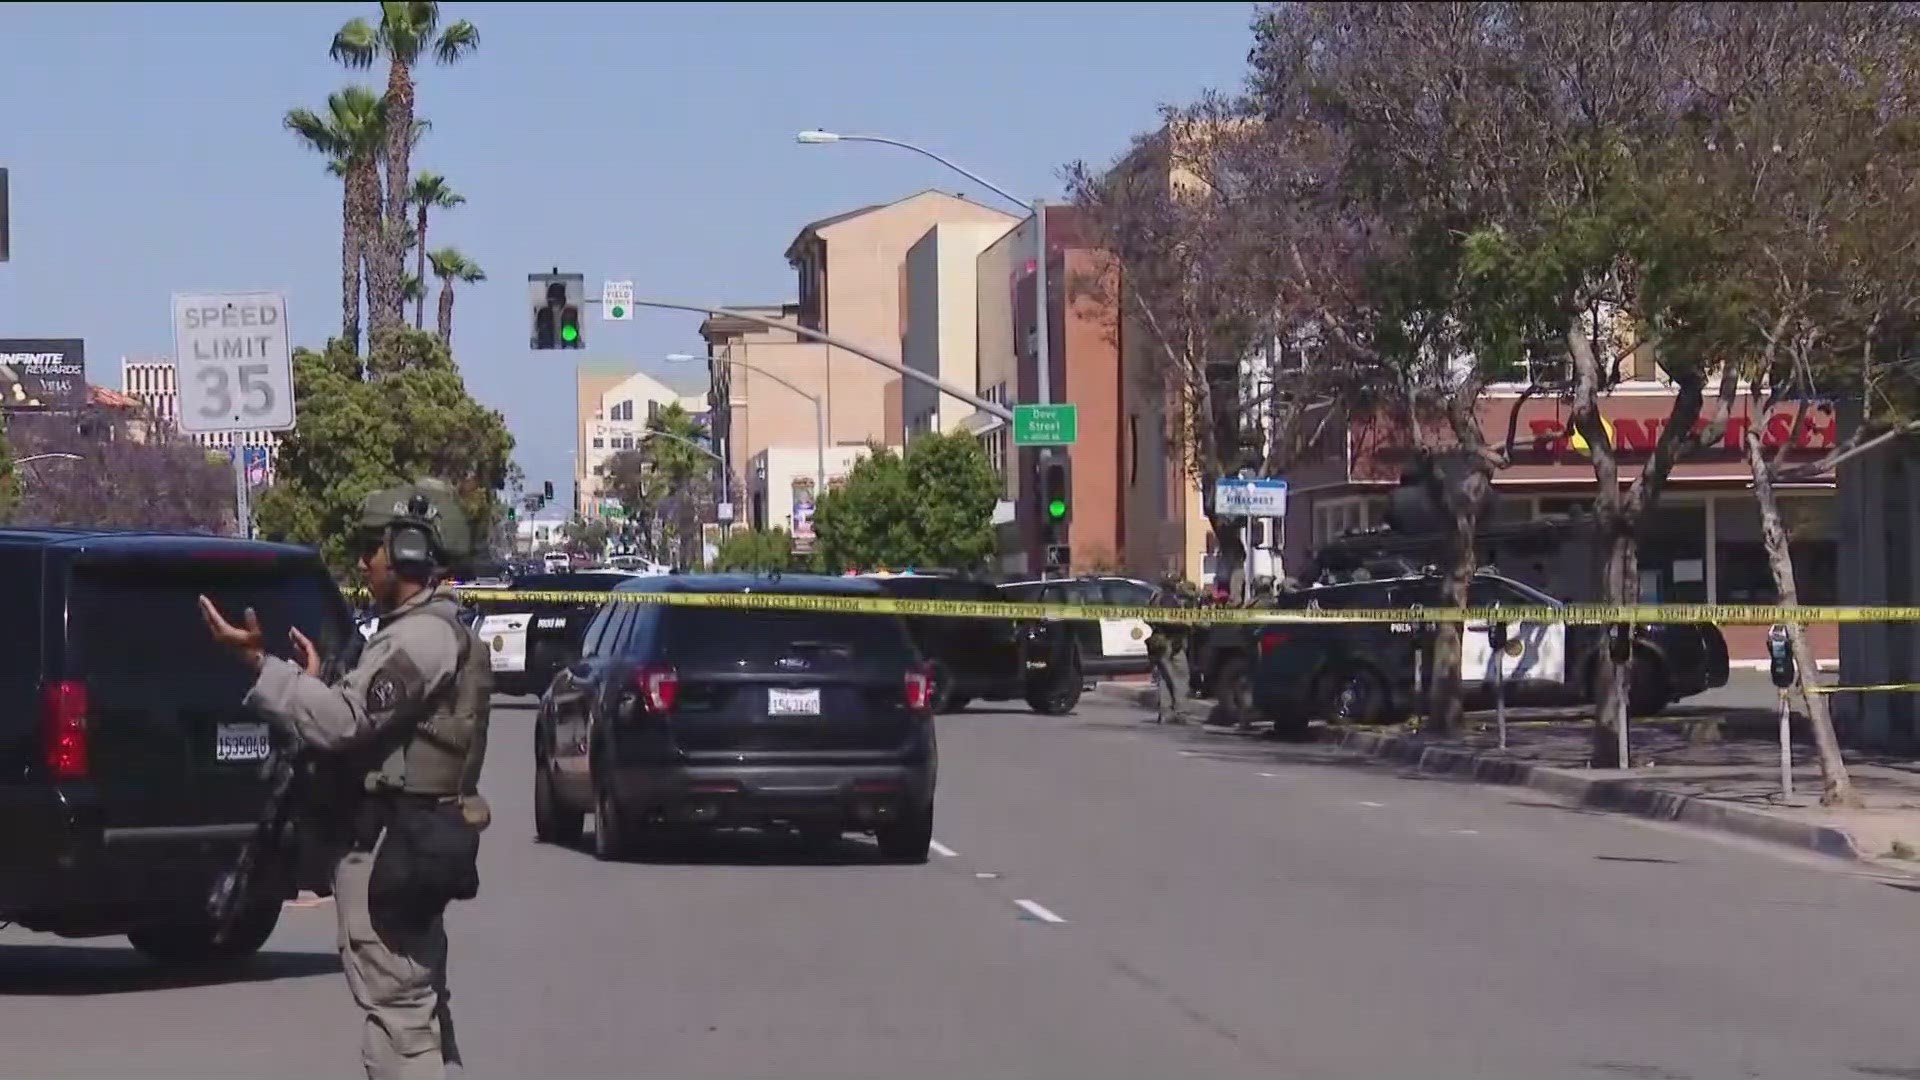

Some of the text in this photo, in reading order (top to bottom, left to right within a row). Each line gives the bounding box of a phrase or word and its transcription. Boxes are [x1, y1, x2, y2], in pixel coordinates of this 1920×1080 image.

[185, 306, 277, 328] SPEED
[194, 336, 272, 359] LIMIT
[25, 365, 81, 374] REWARDS
[196, 364, 275, 418] 35
[1029, 420, 1060, 431] Street
[219, 736, 267, 756] 1535048
